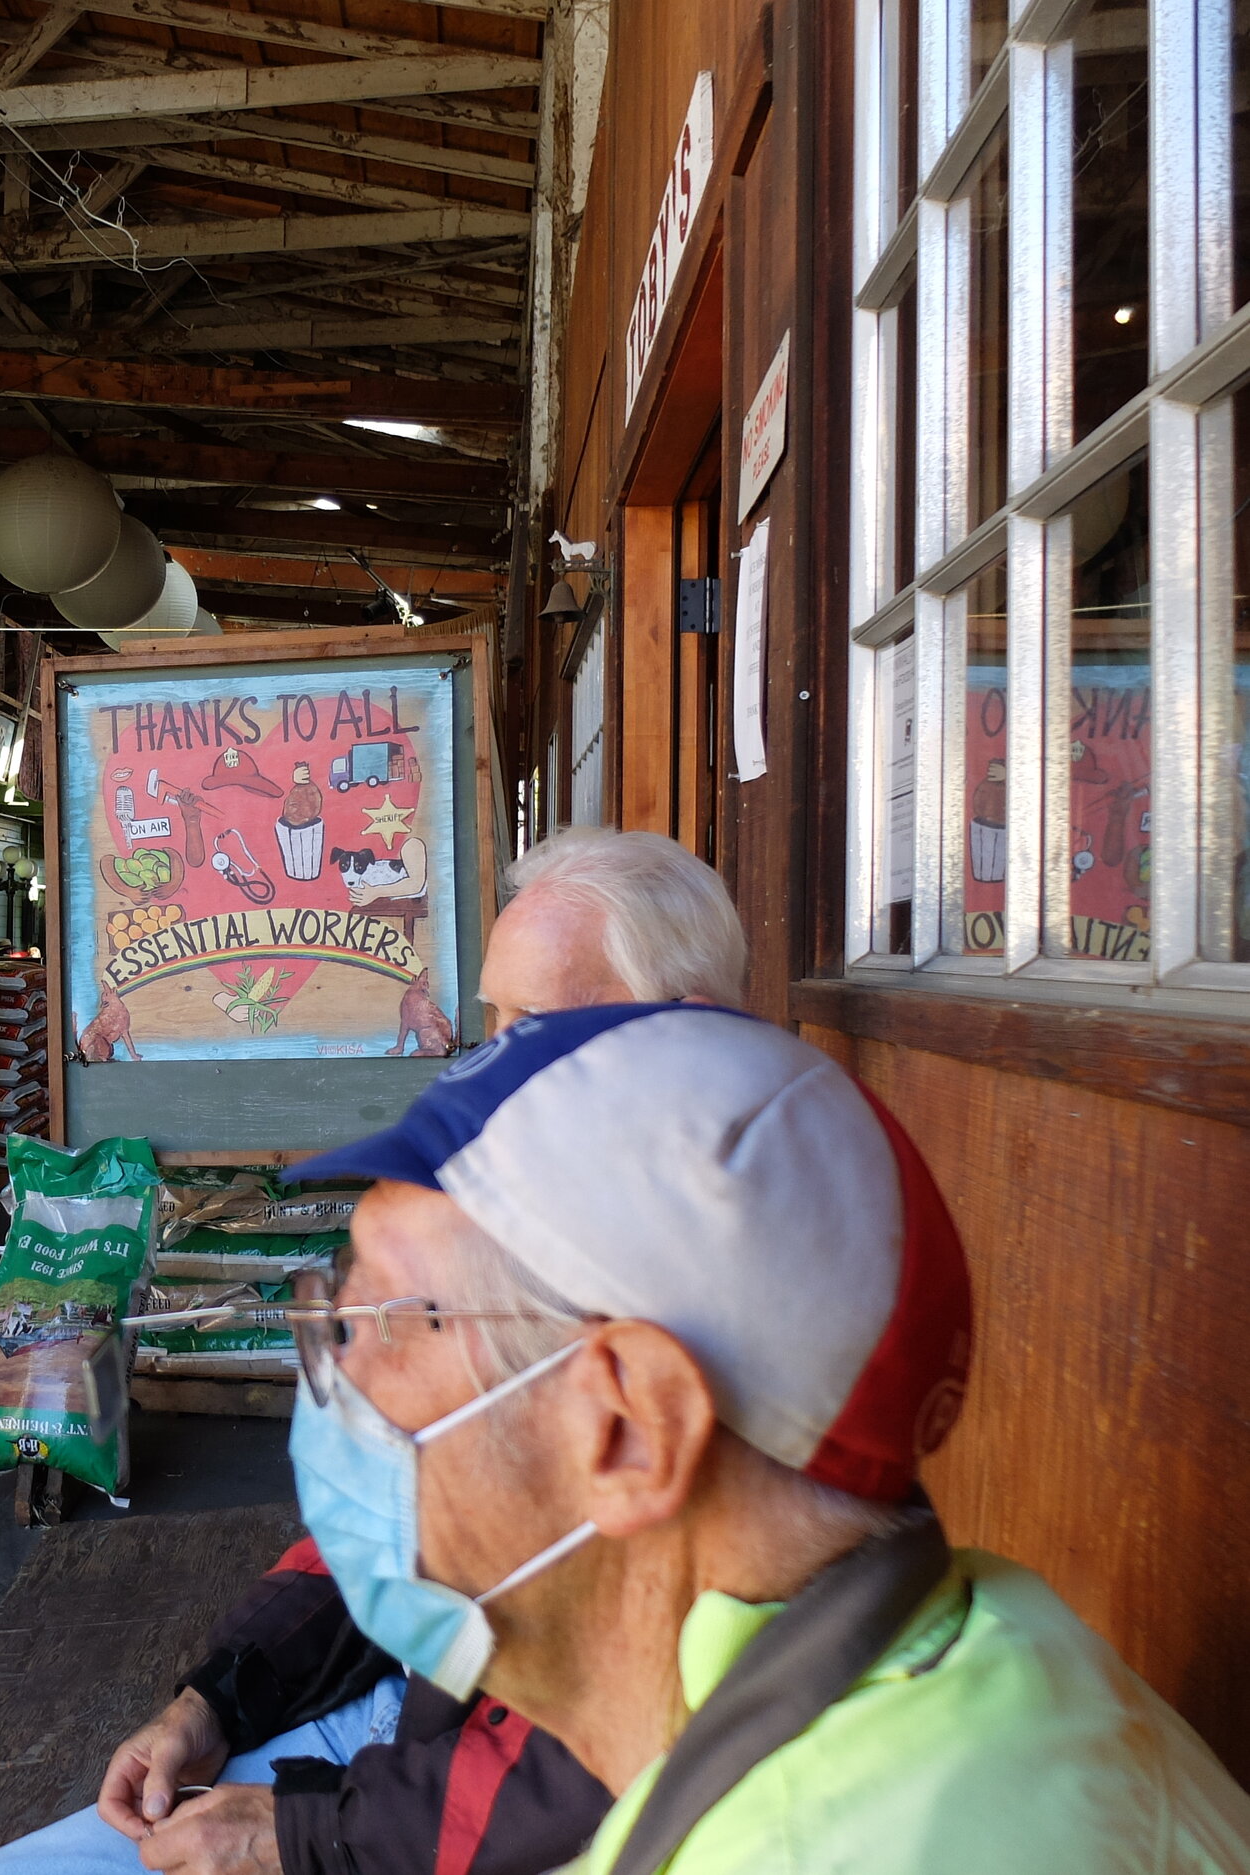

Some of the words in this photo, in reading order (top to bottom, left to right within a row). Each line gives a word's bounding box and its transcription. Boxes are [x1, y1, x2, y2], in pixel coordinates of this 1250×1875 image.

[629, 123, 691, 406] TOBY'S
[742, 428, 752, 469] NO
[754, 361, 785, 446] SMOKING
[752, 436, 770, 482] PLEASE
[99, 696, 261, 753] THANKS
[277, 694, 318, 742] TO
[330, 686, 420, 739] ALL
[131, 824, 146, 835] ON
[150, 821, 168, 832] AIR
[106, 912, 260, 986] ESSENTIAL
[266, 909, 415, 967] WORKERS
[34, 1243, 67, 1261] FOOD
[103, 1240, 130, 1258] IT'S
[31, 1260, 55, 1277] 1921
[56, 1259, 84, 1279] SINCE
